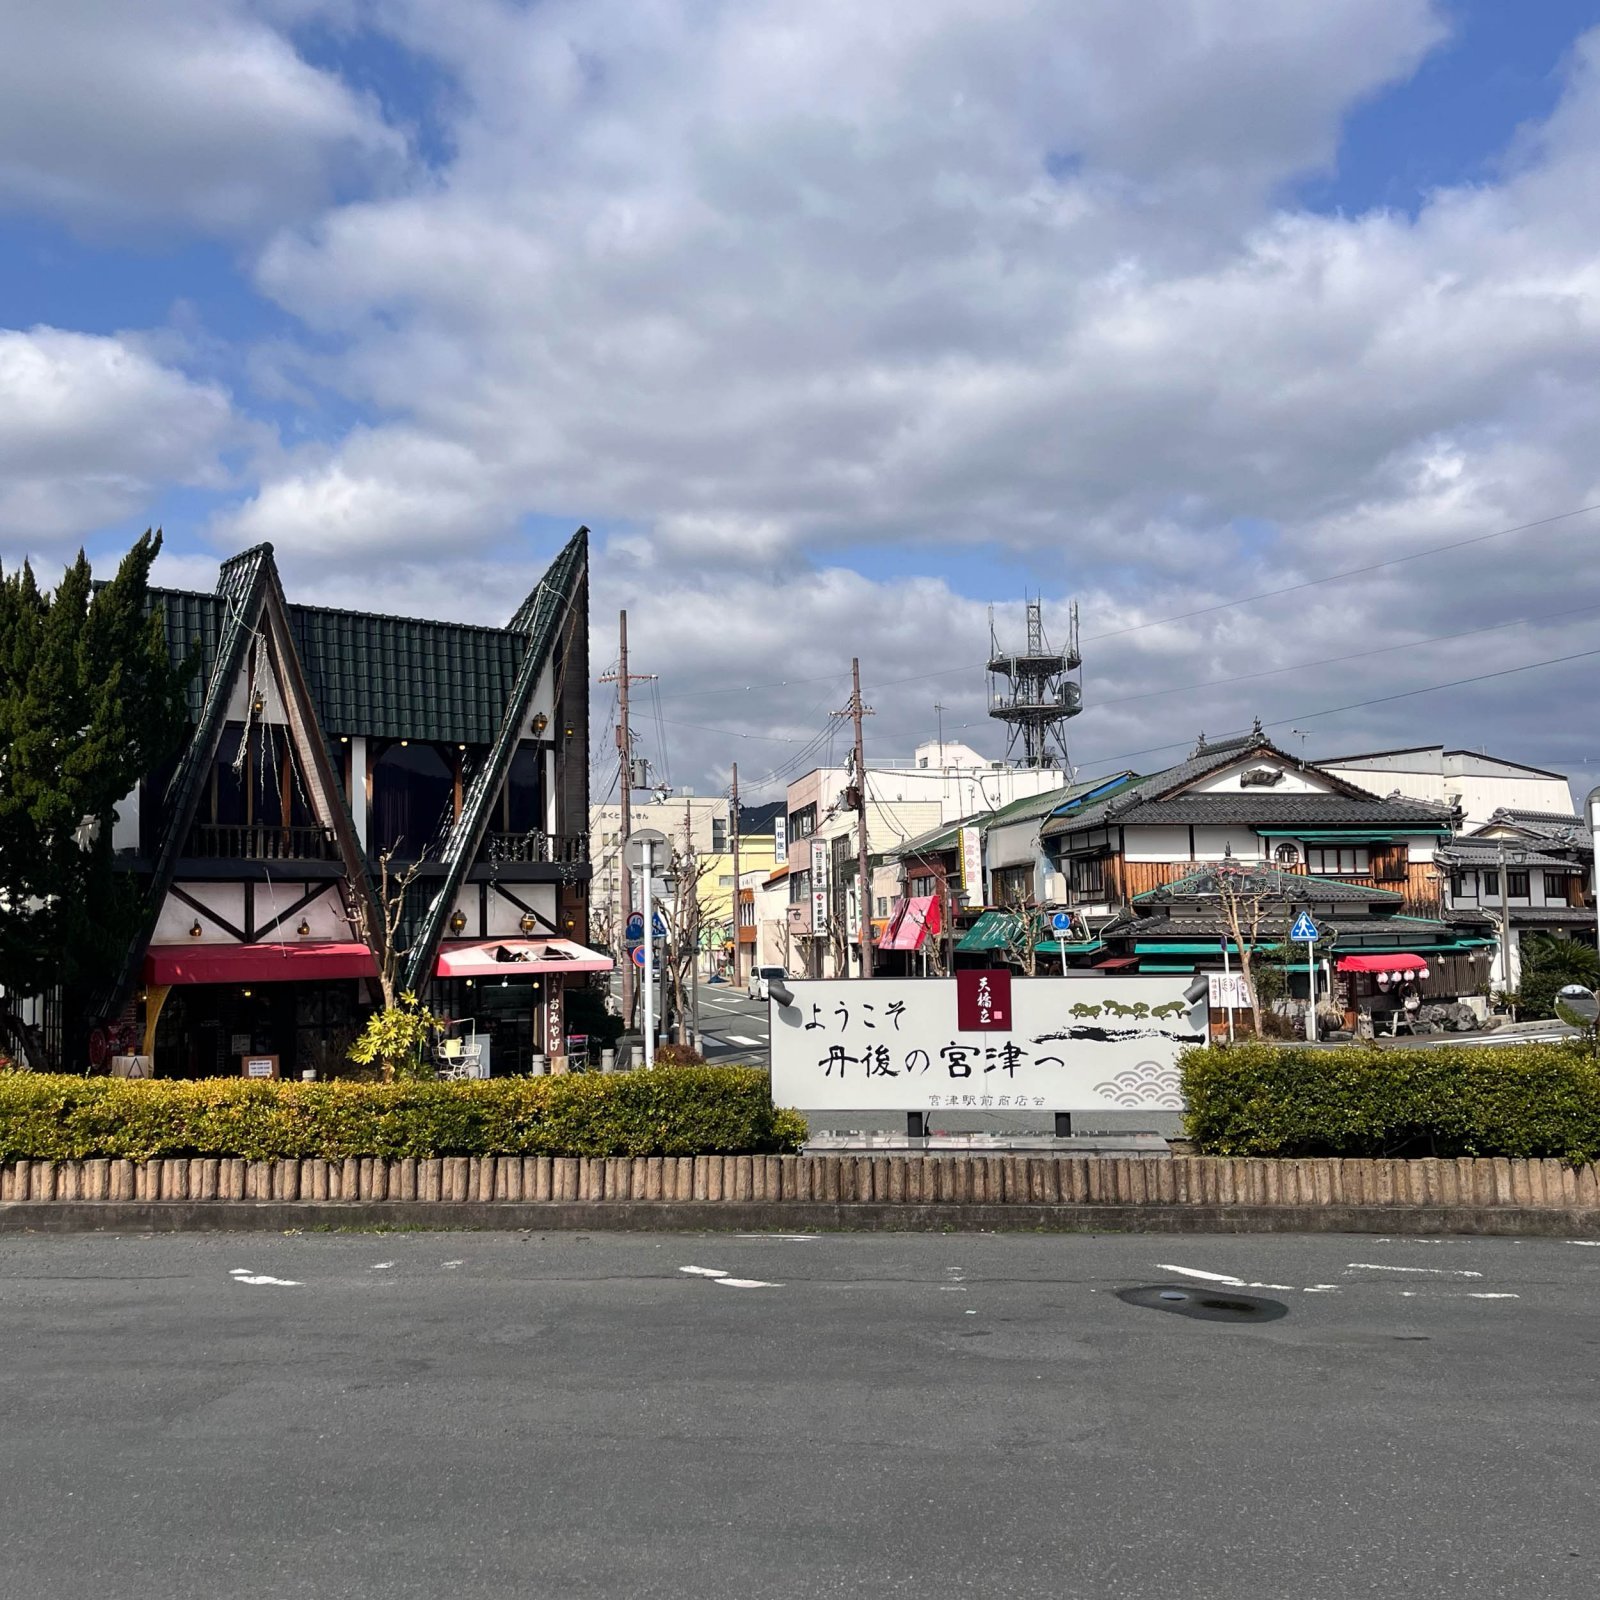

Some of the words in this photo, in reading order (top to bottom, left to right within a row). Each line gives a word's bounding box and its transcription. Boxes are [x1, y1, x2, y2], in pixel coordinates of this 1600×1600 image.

[601, 812, 649, 820] ほくとんきん
[804, 1000, 907, 1033] ようこそ
[976, 976, 992, 1024] 天橋立
[549, 998, 560, 1052] おみやげ
[818, 1040, 1065, 1079] 丹後の宮津へ
[928, 1094, 1046, 1107] 宮津駅前商店会
